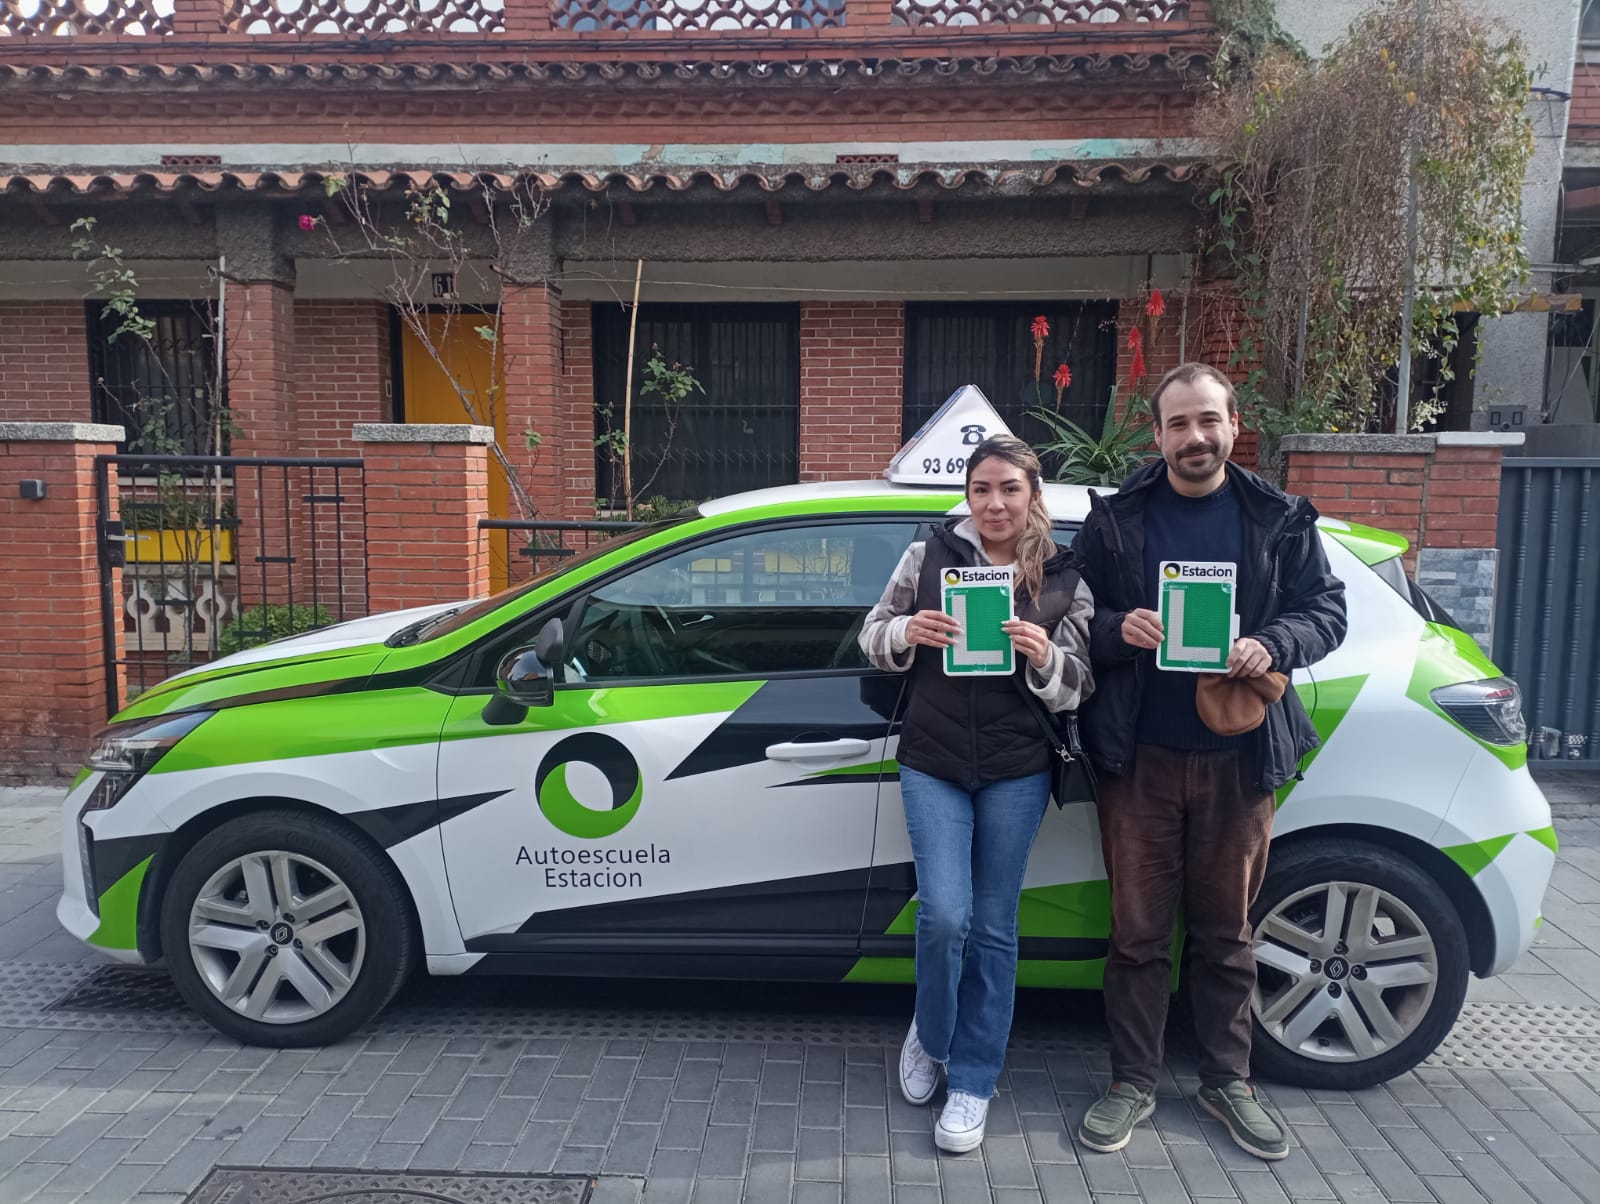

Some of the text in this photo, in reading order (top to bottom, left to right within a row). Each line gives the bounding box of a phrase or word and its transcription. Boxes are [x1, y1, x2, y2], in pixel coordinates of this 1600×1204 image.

[434, 275, 452, 297] 61
[923, 457, 941, 474] 93
[962, 569, 1010, 582] Estacion
[1182, 565, 1233, 577] Estacion
[951, 594, 1004, 666] L
[1166, 588, 1221, 663] L
[515, 843, 671, 865] Autoescuela
[545, 867, 642, 888] Estacion
